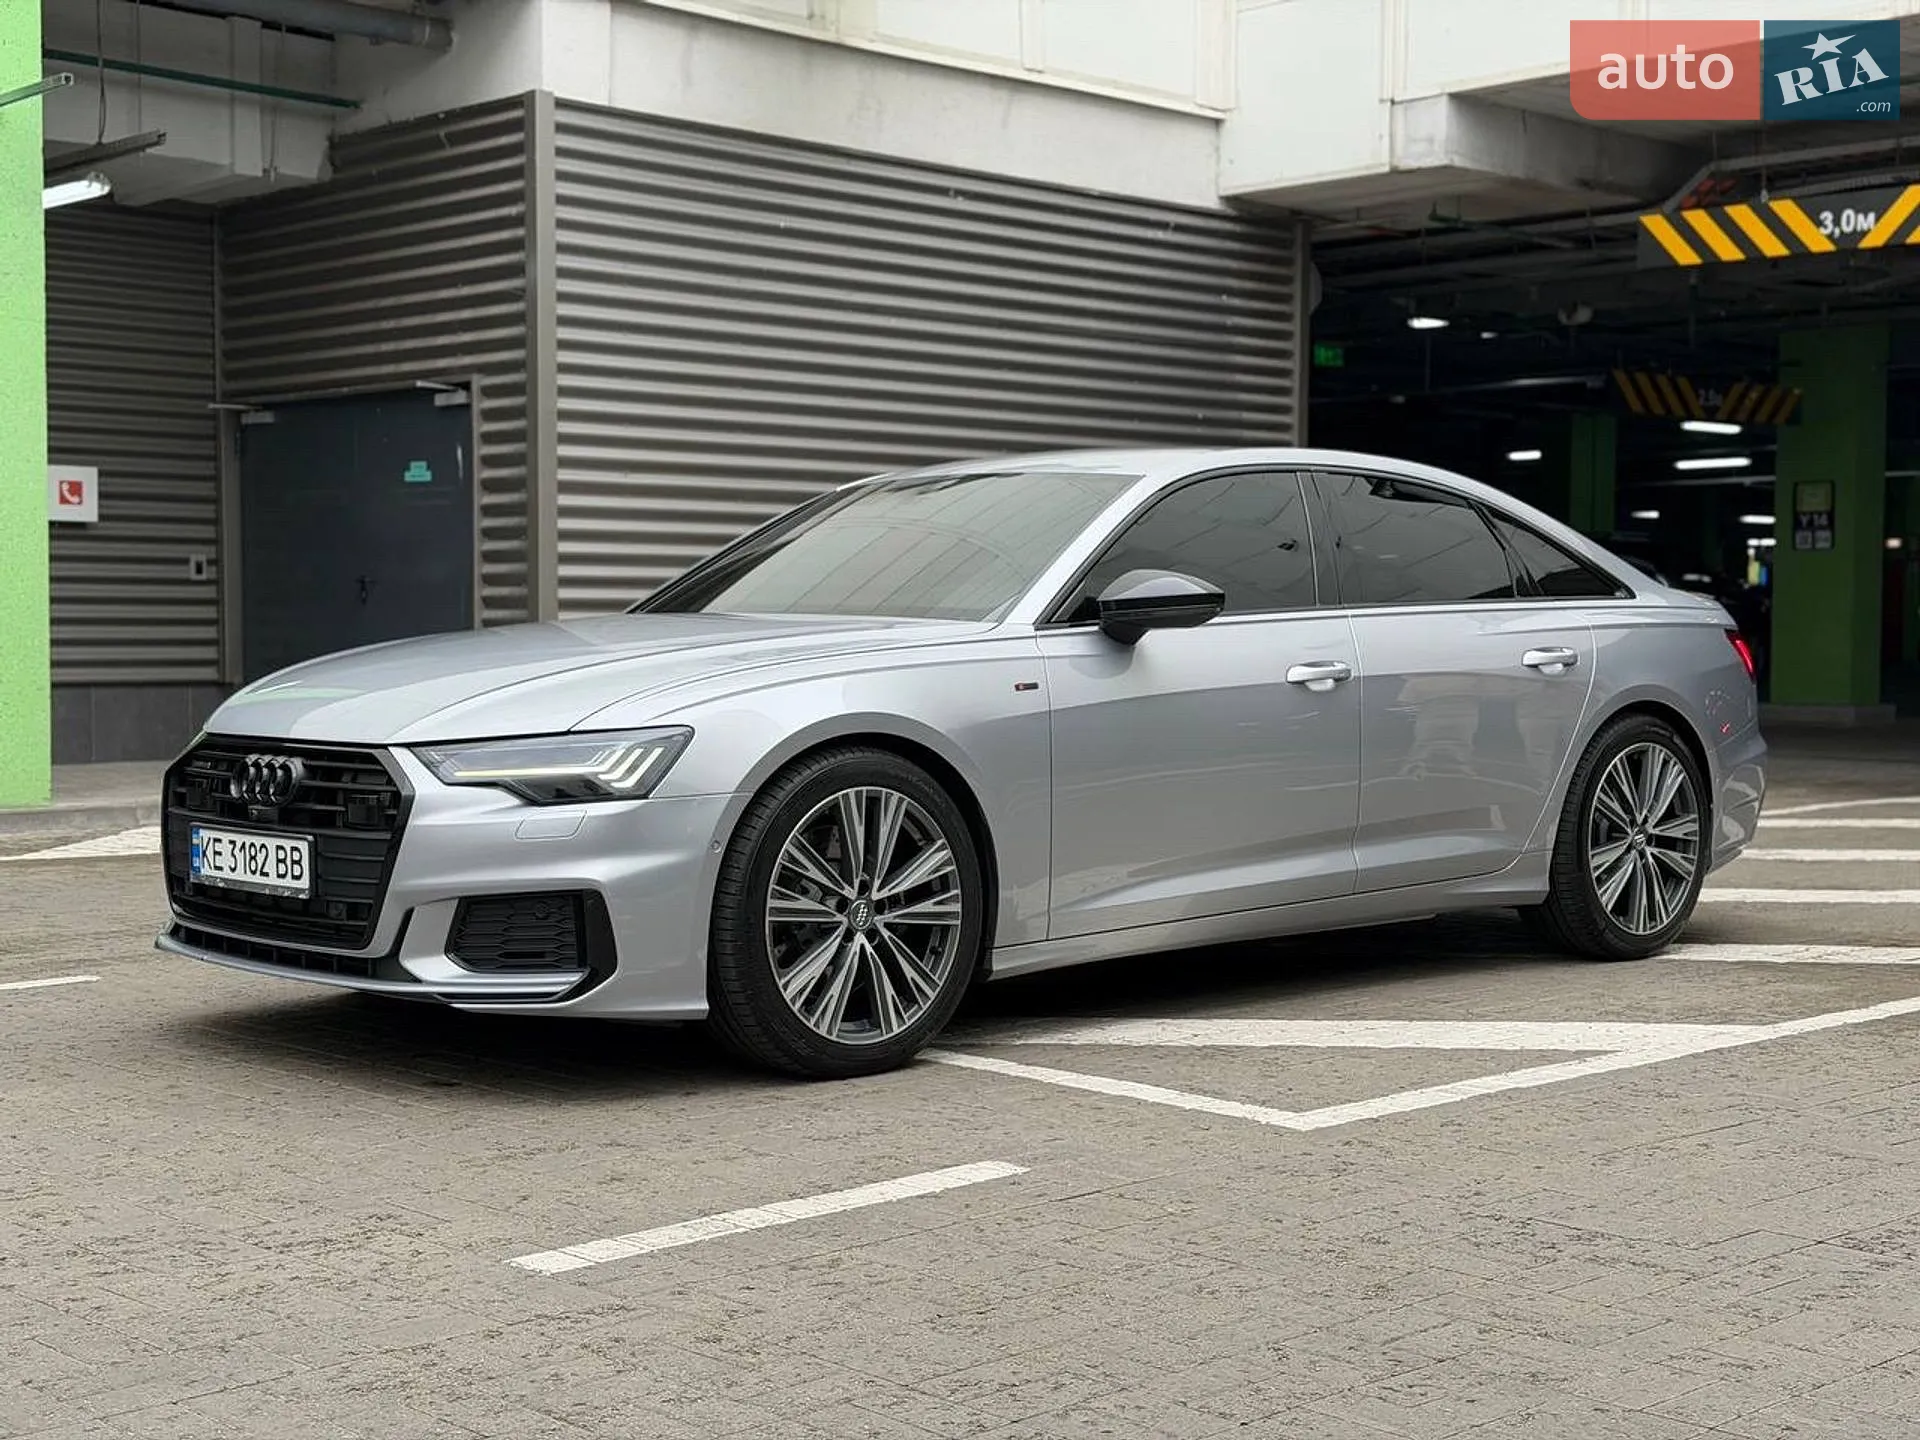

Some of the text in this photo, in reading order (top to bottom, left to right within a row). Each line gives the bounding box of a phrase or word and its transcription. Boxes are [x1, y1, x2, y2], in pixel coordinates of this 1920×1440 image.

[201, 835, 304, 881] KE 3182 BB
